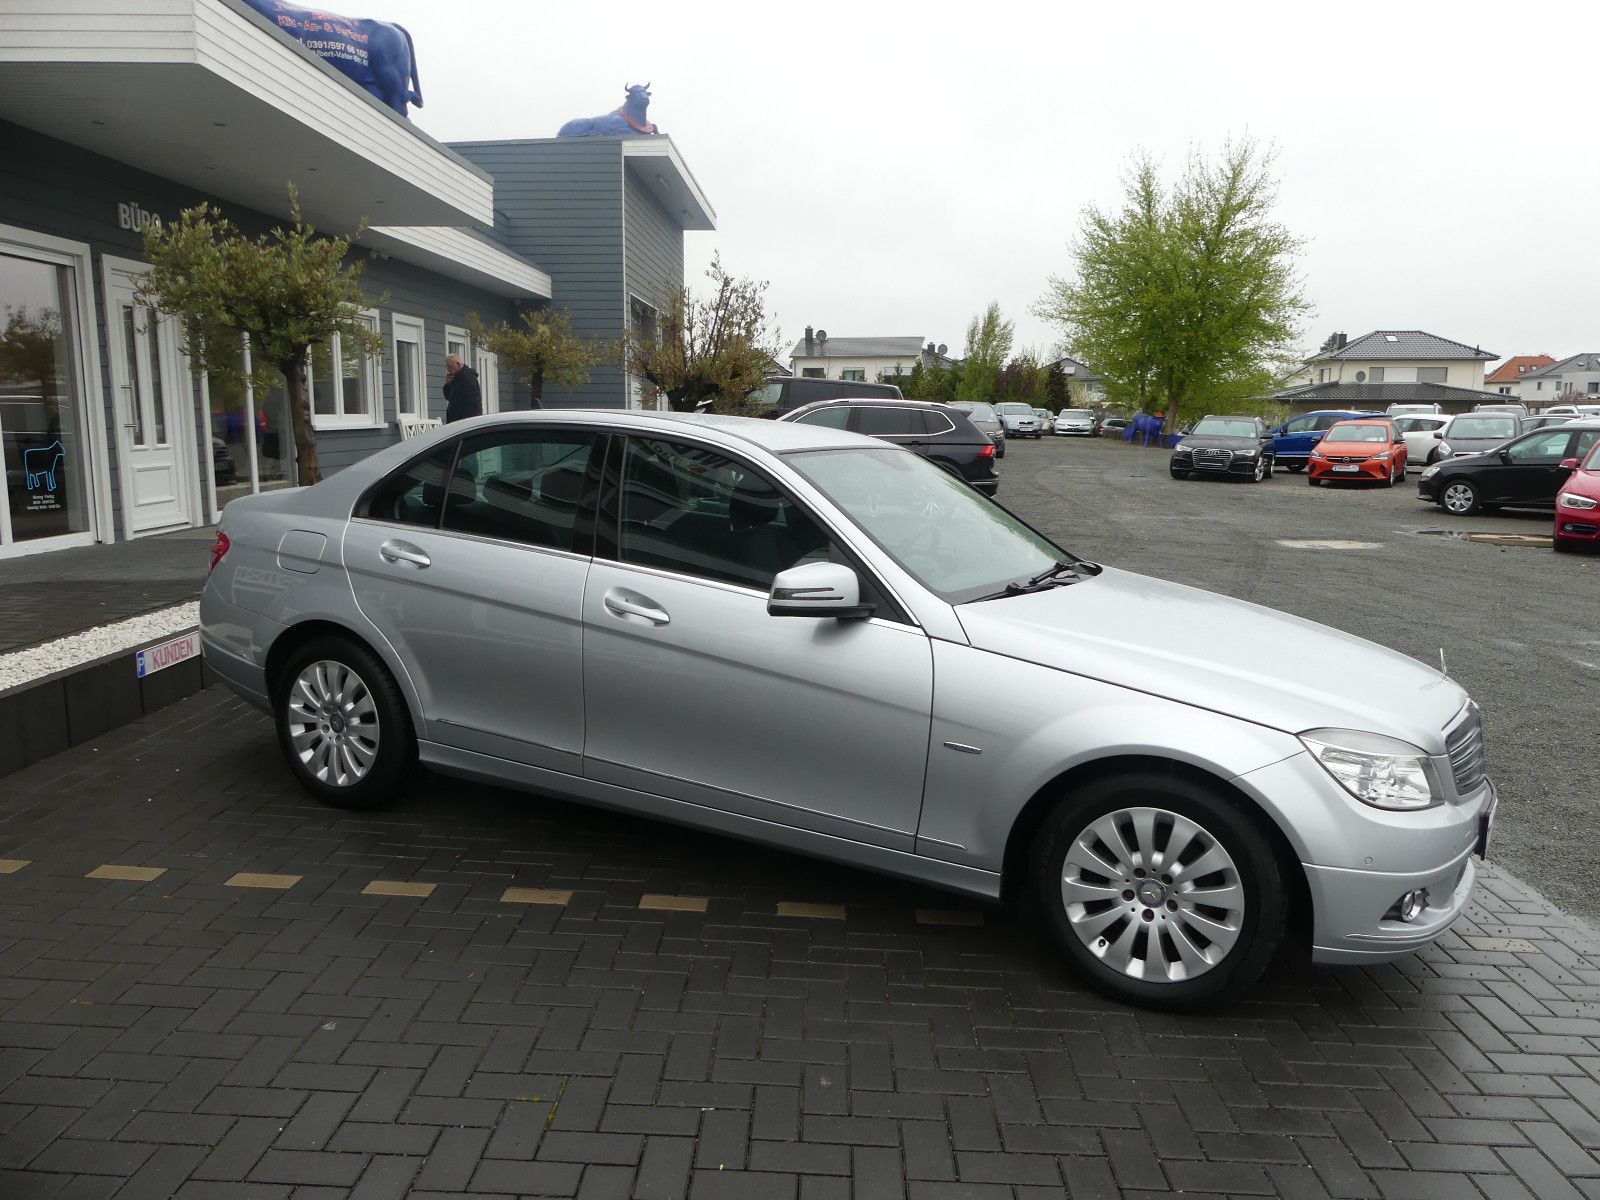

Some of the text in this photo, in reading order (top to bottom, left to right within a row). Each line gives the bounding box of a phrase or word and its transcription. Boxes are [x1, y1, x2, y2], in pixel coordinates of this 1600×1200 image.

[306, 40, 345, 50] 0391/597
[356, 48, 368, 58] 100
[152, 638, 194, 670] KUNDEN
